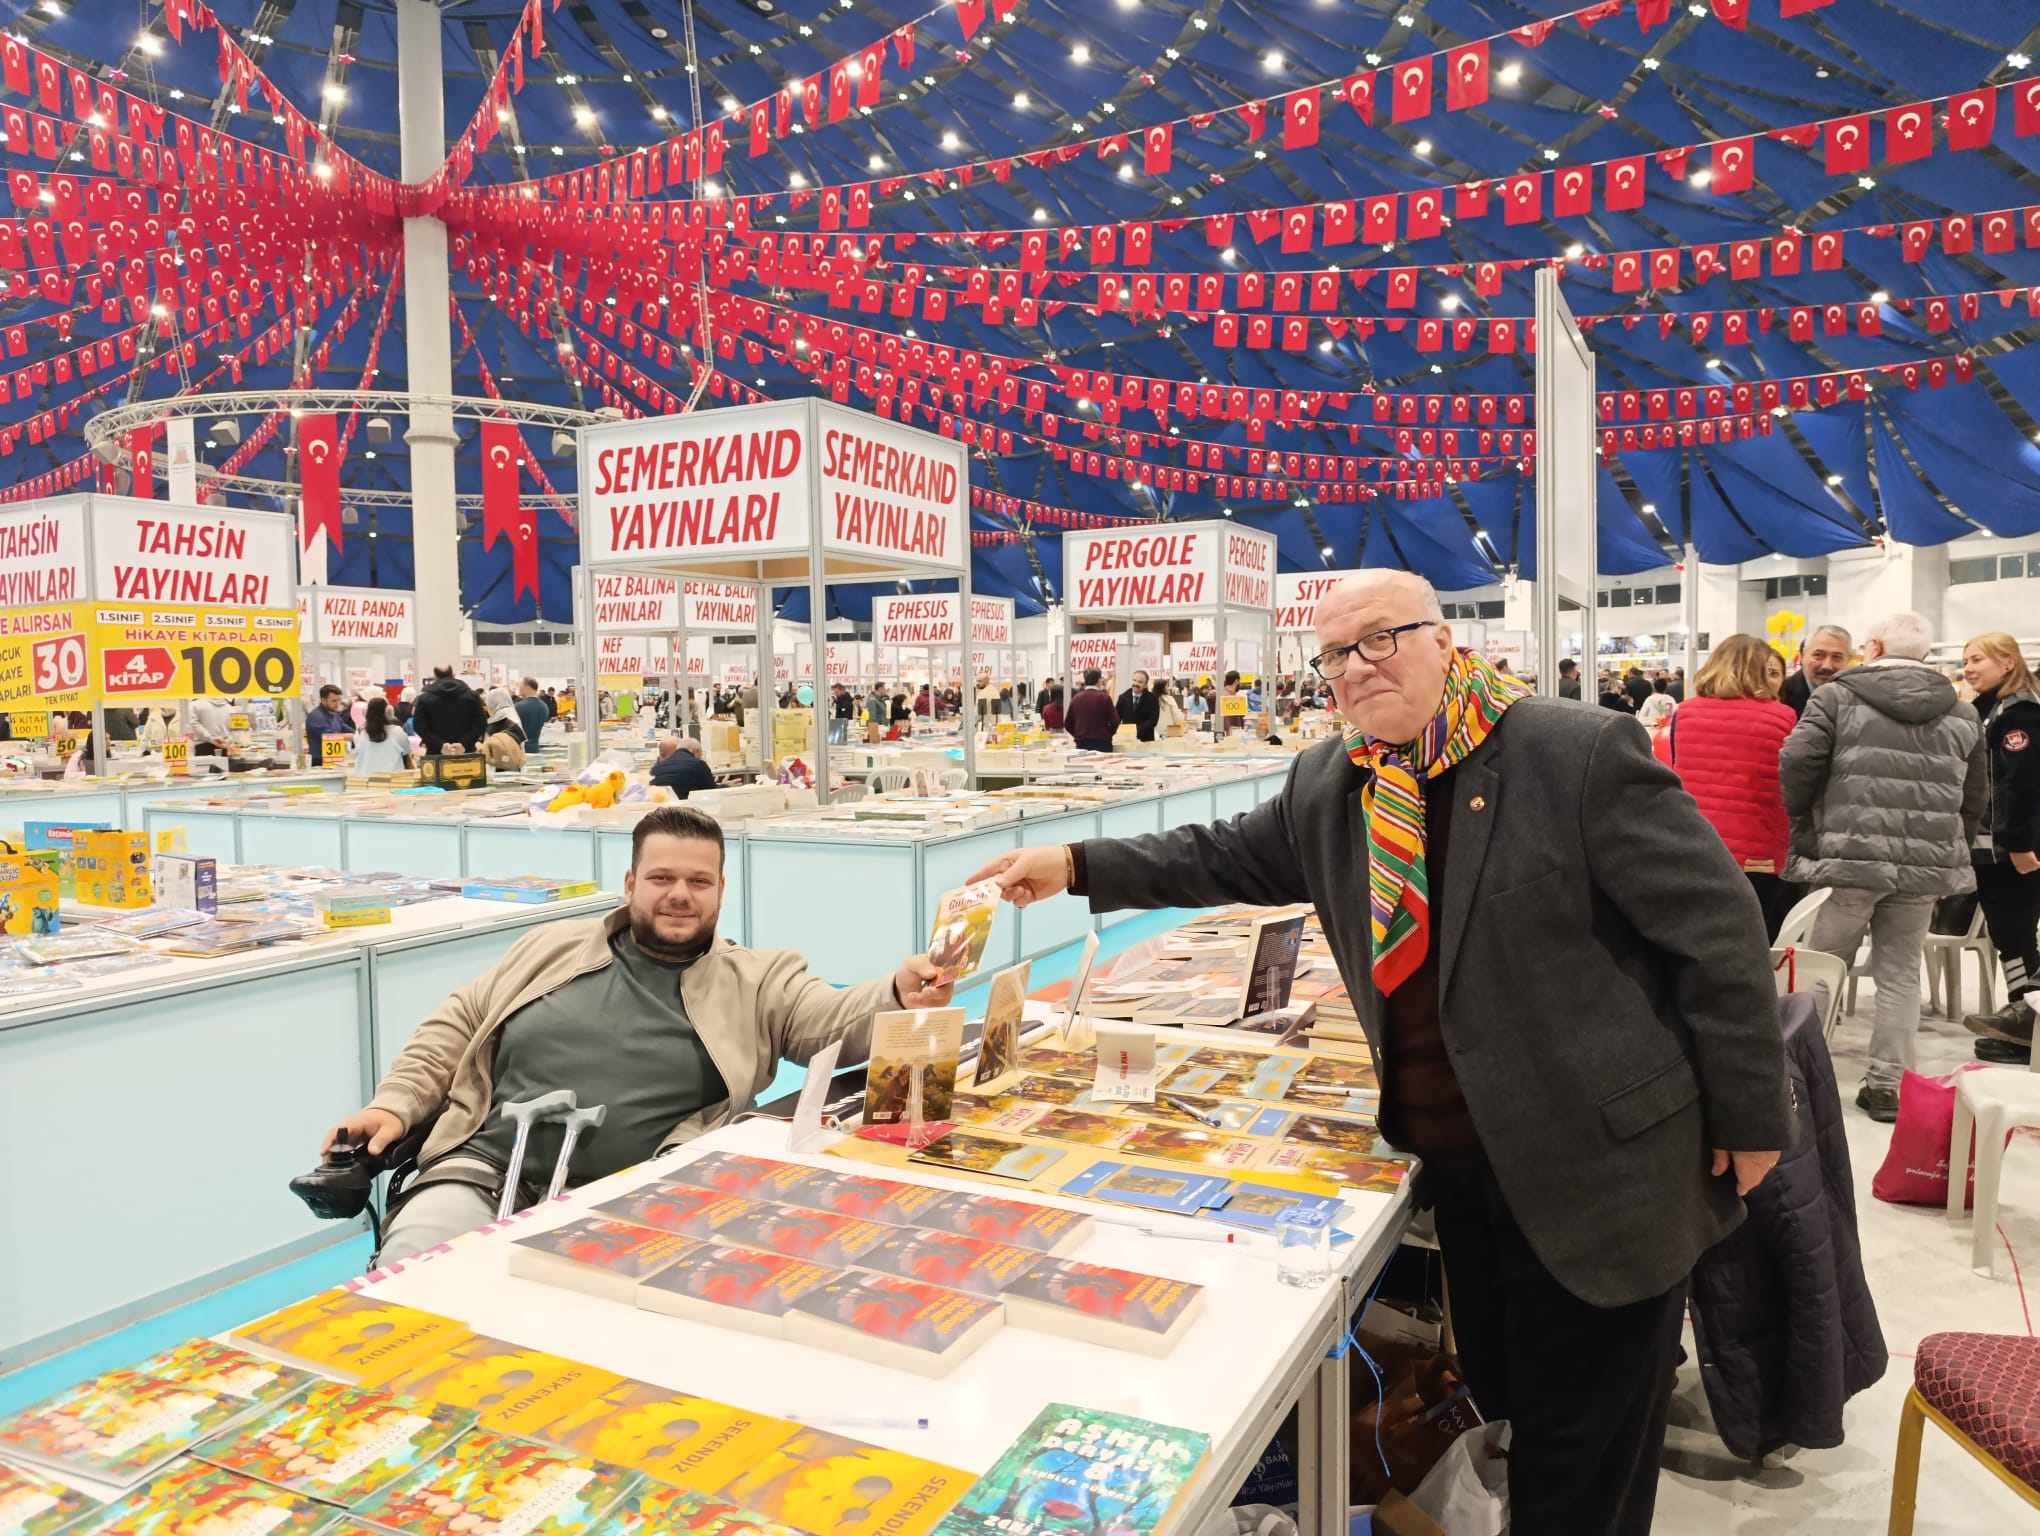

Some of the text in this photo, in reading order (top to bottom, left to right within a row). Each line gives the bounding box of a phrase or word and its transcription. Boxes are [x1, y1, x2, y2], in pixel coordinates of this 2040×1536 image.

[595, 428, 801, 496] SEMERKAND
[823, 429, 957, 505] SEMERKAND
[610, 492, 780, 552] YAYINLARI
[835, 492, 946, 558] YAYINLARI
[0, 514, 59, 558] TAHSİN
[137, 520, 246, 559] TAHSİN
[1085, 534, 1196, 570] PERGOLE
[1229, 534, 1266, 571] PERGOLE
[0, 567, 75, 604] AYINLARI
[114, 566, 269, 604] YAYINLARI
[595, 577, 622, 598] YAZ
[1078, 572, 1203, 607] YAYINLARI
[1225, 570, 1269, 608] YAYINLARI
[1296, 578, 1343, 600] SİYE
[324, 598, 357, 616] KIZIL
[361, 601, 405, 618] PANDA
[596, 600, 662, 622] AYINLARI
[696, 600, 756, 623] YAYINLARI
[888, 600, 948, 620] EPHESUS
[971, 601, 1005, 620] EPHESUS
[12, 612, 72, 633] ALIRSAN
[100, 613, 293, 627] 1.SINIF 2.SINIF 3.SINIF 4.SINIF
[331, 619, 398, 638] YAYINLARI
[883, 622, 953, 642] YAYINLARI
[972, 623, 1008, 642] AYINLARI
[0, 647, 21, 661] CUK
[603, 637, 623, 653] NEF
[1071, 639, 1116, 653] MORENA
[1189, 646, 1217, 657] ALTIN
[0, 666, 23, 681] KAYE
[37, 639, 84, 689] 30
[126, 655, 147, 672] 4
[181, 647, 294, 694] 100
[599, 656, 641, 673] YINLARI
[1071, 656, 1116, 671] AYINLAR
[1178, 660, 1227, 672] YAYINLAI
[109, 671, 164, 686] KİTAP
[0, 684, 31, 701] APLARI
[45, 695, 57, 705] TEK
[15, 726, 31, 734] 100
[57, 738, 76, 752] 50
[165, 745, 187, 760] 100
[326, 742, 341, 755] 30
